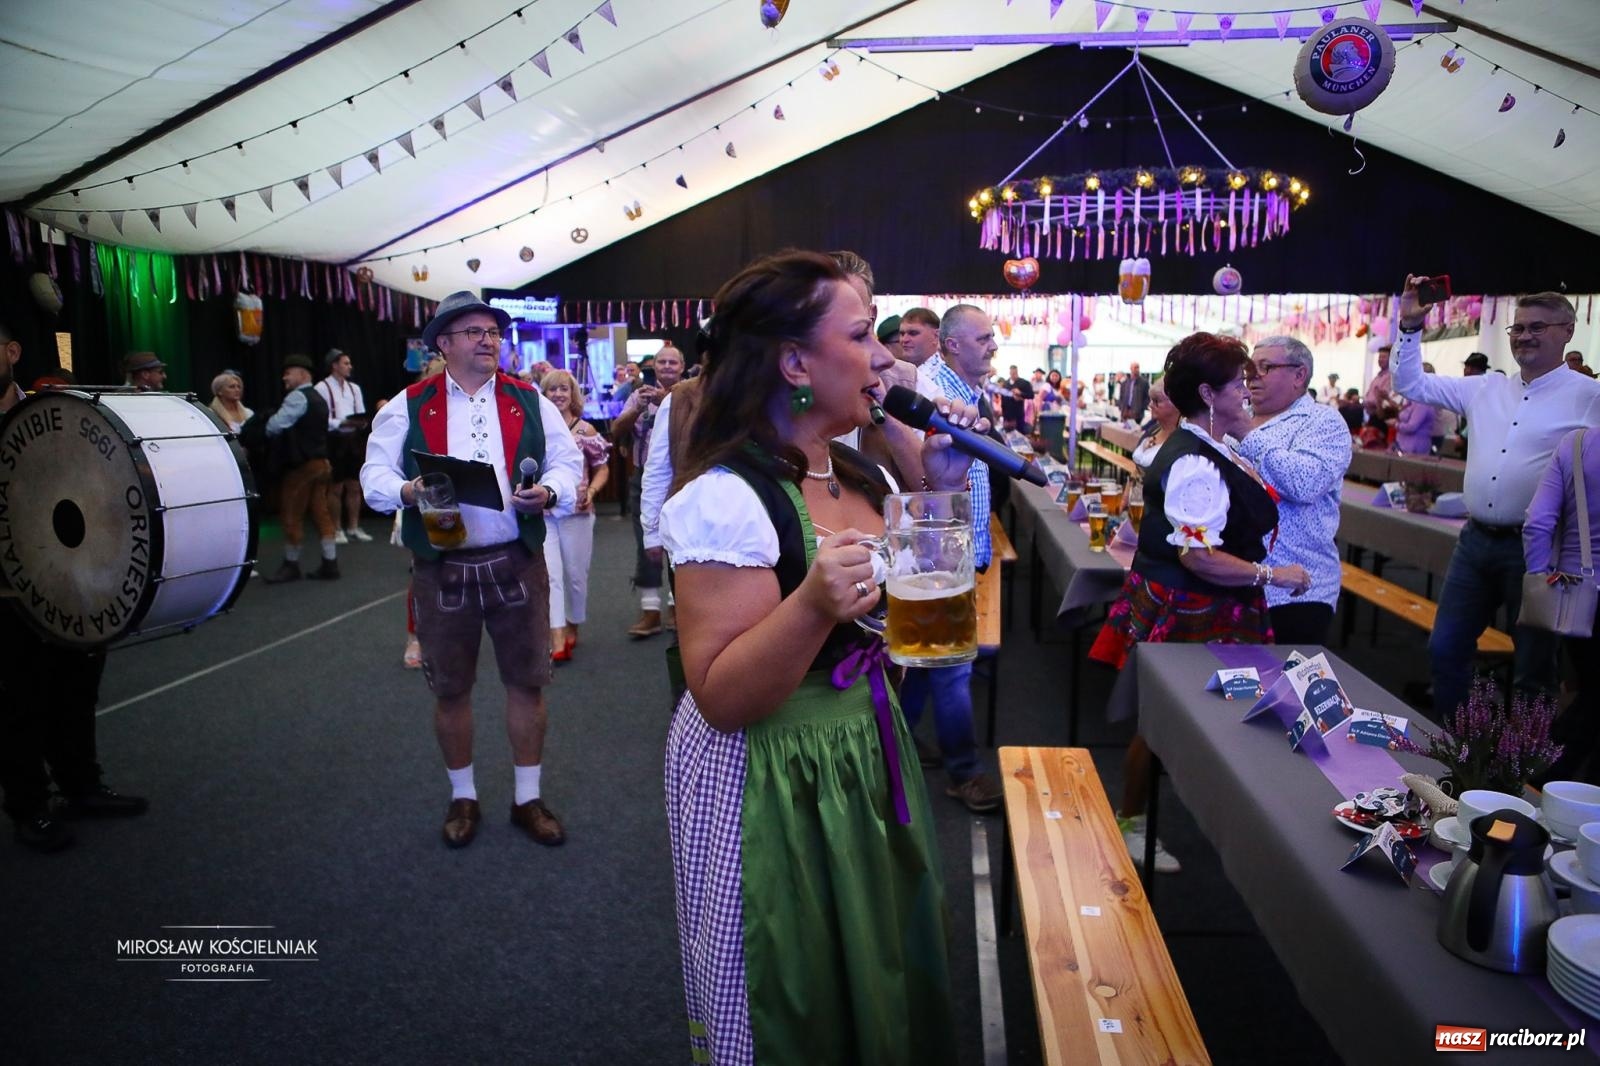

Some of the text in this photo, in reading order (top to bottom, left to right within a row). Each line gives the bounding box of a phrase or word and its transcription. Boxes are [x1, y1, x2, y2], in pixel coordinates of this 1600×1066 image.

[1312, 25, 1375, 60] PAULANER
[79, 417, 117, 461] 1995
[90, 485, 149, 635] ORKIESTRA
